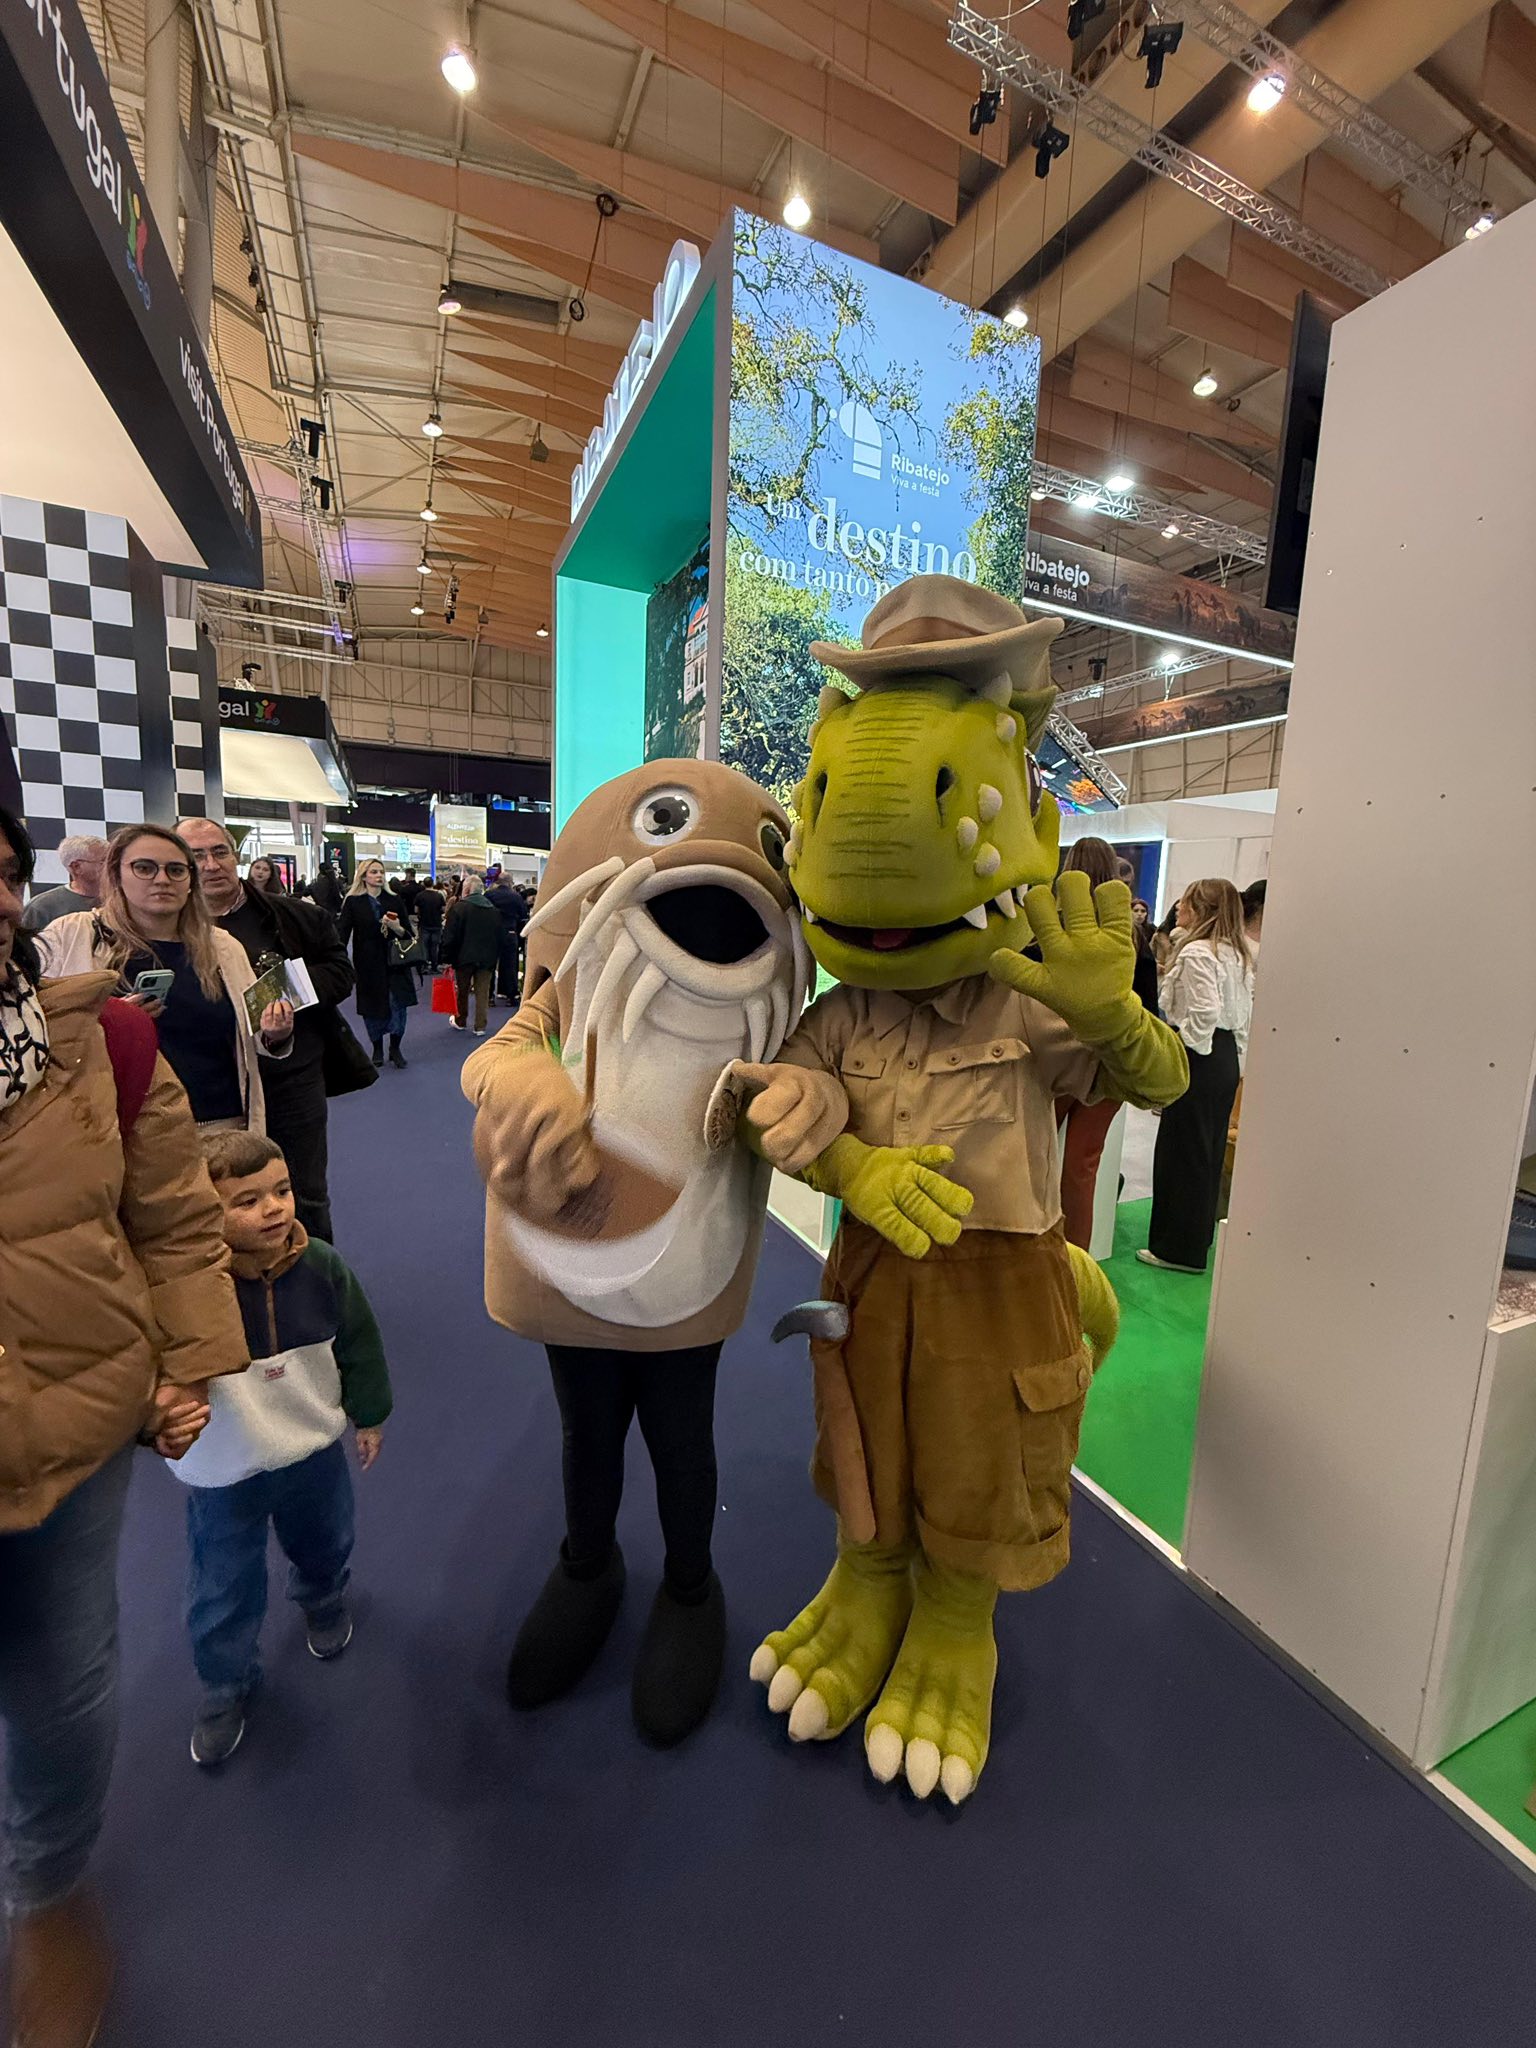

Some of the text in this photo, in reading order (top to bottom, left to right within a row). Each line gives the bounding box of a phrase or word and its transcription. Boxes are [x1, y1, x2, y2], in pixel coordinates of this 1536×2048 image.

[25, 0, 123, 225] rtugal
[206, 393, 245, 516] Portugal
[891, 453, 950, 486] Ribatejo
[891, 473, 940, 497] Viva a festa
[767, 493, 977, 583] Um destino
[740, 551, 796, 582] com
[802, 560, 870, 597] tanto
[1025, 577, 1078, 602] iva a festa
